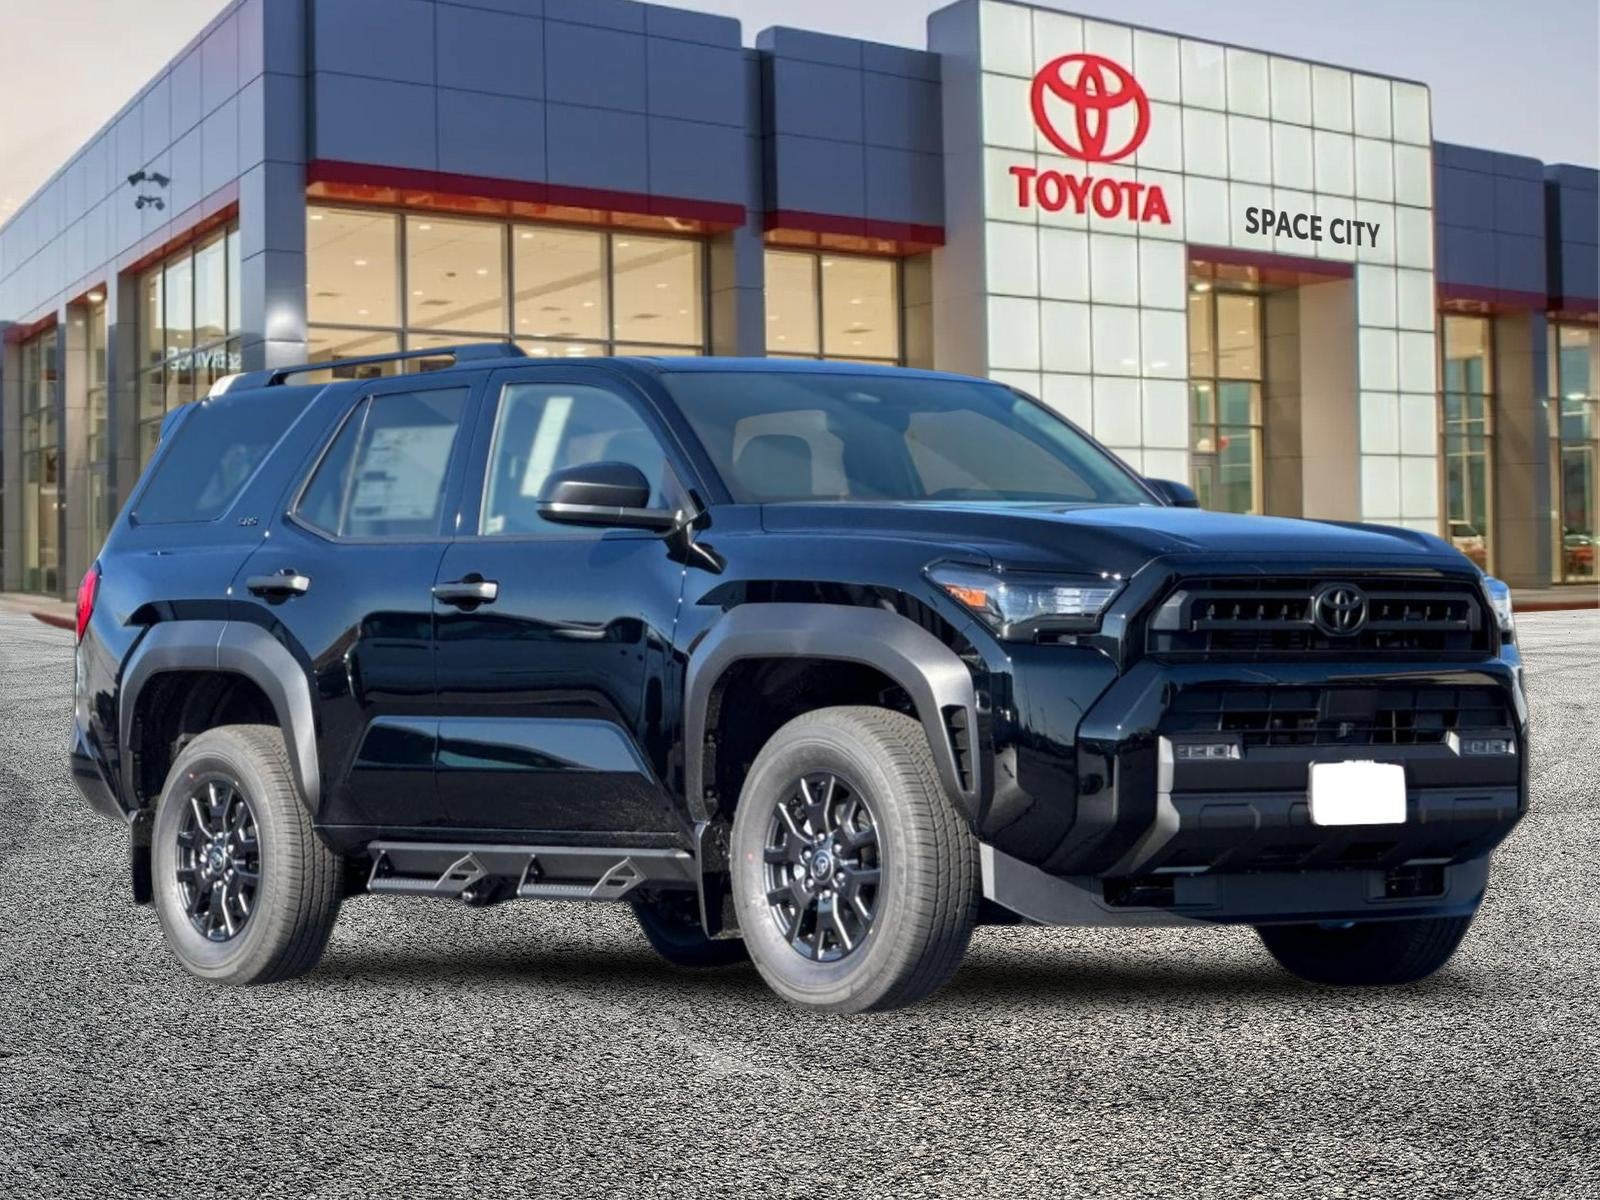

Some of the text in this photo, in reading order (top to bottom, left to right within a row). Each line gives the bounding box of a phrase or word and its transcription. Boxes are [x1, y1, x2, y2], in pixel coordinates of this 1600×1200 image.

[1009, 166, 1171, 224] TOYOTA
[1245, 206, 1381, 247] SPACE CITY
